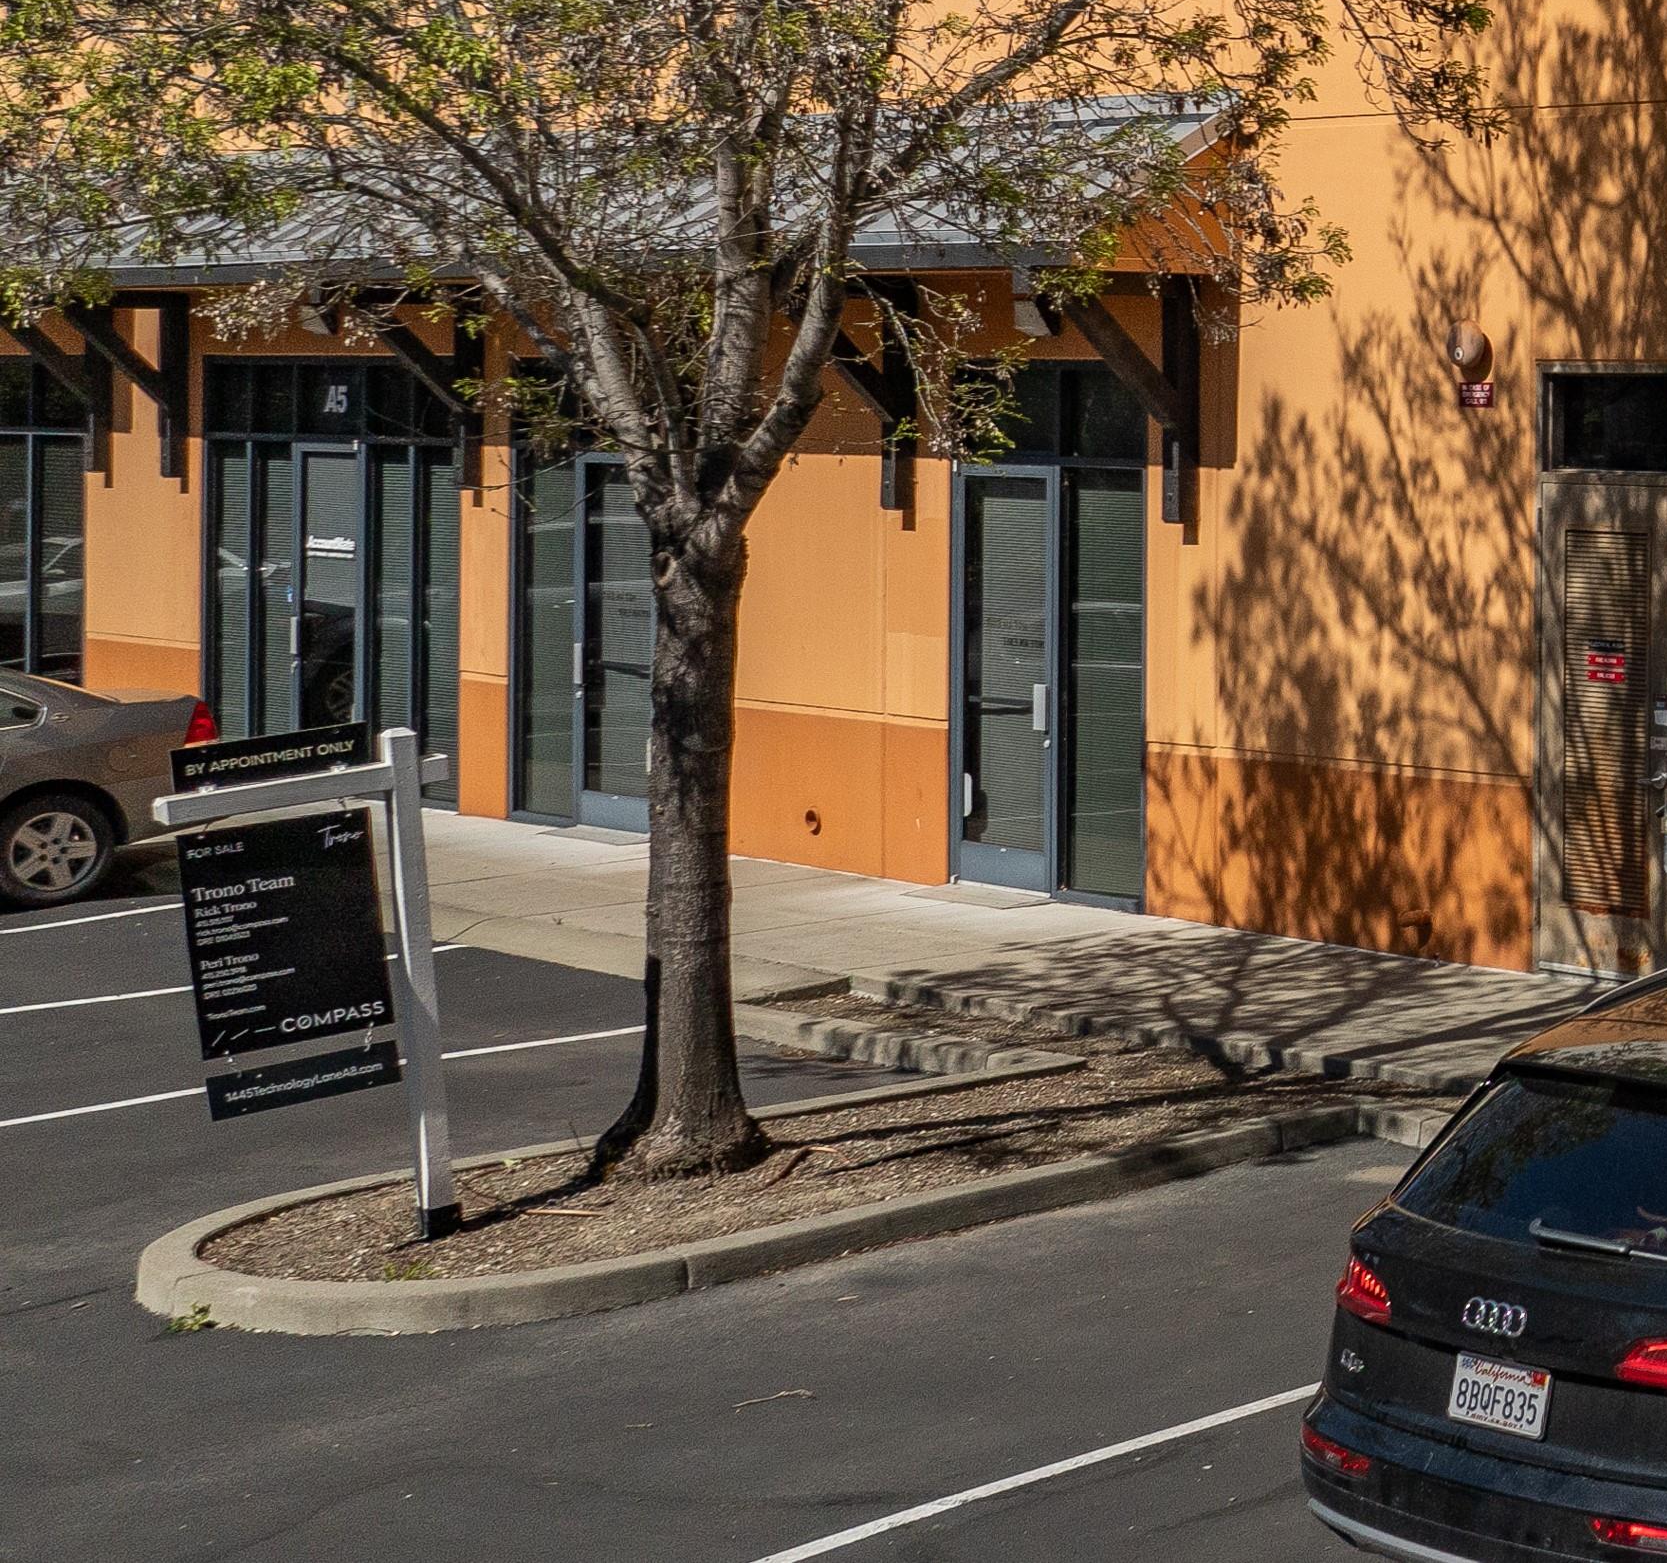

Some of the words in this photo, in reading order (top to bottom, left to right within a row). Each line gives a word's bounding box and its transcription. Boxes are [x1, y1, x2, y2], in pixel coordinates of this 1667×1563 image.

[323, 385, 348, 413] A5
[185, 763, 206, 776] BY
[208, 746, 314, 772] APPOINTMENT
[317, 739, 355, 756] ONLY
[186, 847, 212, 860] FOR
[215, 841, 245, 854] SALE
[191, 883, 245, 902] Trono
[245, 876, 297, 893] Team
[194, 905, 221, 918] Rick
[221, 902, 258, 913] Trono
[200, 958, 223, 970] Peri
[223, 953, 259, 966] Trono
[281, 1001, 386, 1033] COMPASS
[1474, 1358, 1527, 1383] California
[1456, 1378, 1539, 1425] 8BQF835
